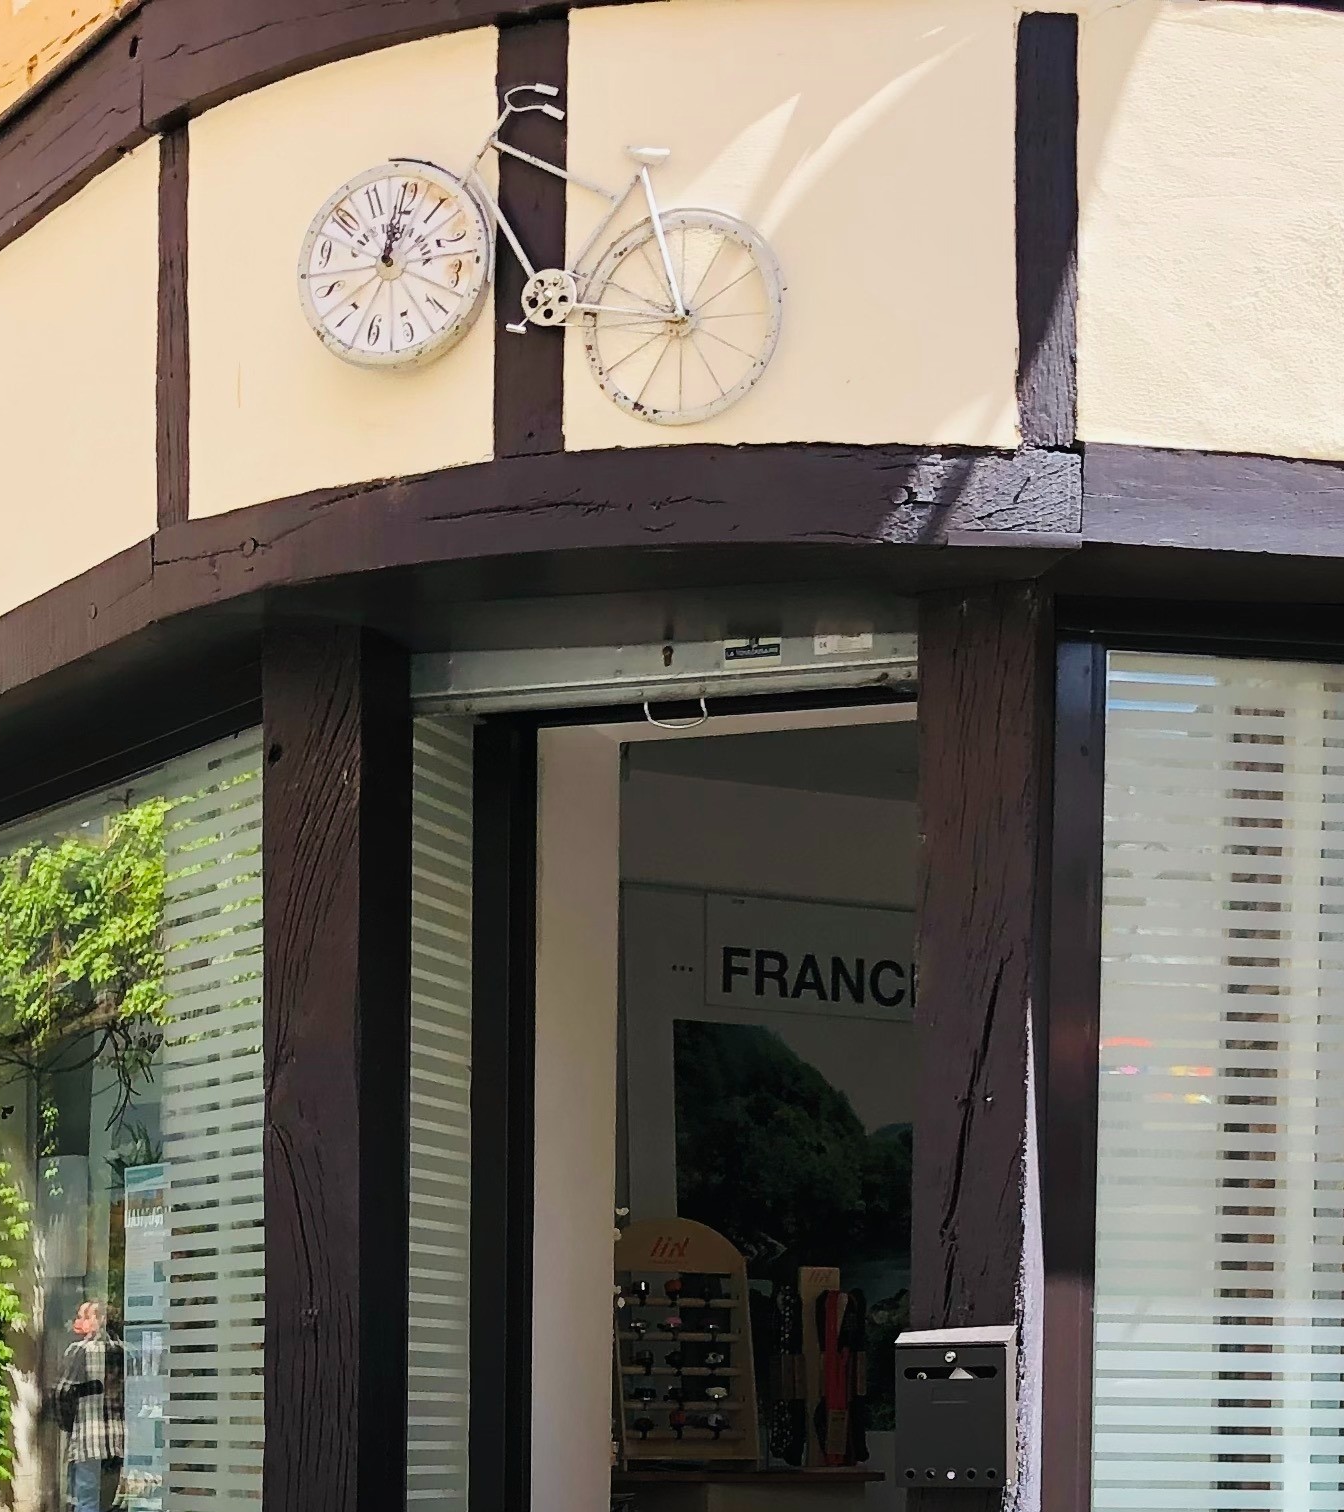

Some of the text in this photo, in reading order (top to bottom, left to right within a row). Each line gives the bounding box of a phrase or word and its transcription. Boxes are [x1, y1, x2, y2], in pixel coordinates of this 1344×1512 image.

[364, 184, 385, 219] 11
[400, 181, 418, 215] 12
[423, 197, 449, 224] 1
[332, 208, 360, 237] 10
[436, 230, 467, 248] 2
[319, 240, 332, 268] 9
[448, 259, 462, 288] 3
[315, 280, 346, 298] 8
[335, 302, 359, 329] 7
[425, 293, 449, 315] 4
[367, 314, 383, 347] 6
[400, 309, 414, 343] 5
[722, 946, 916, 1008] FRANC
